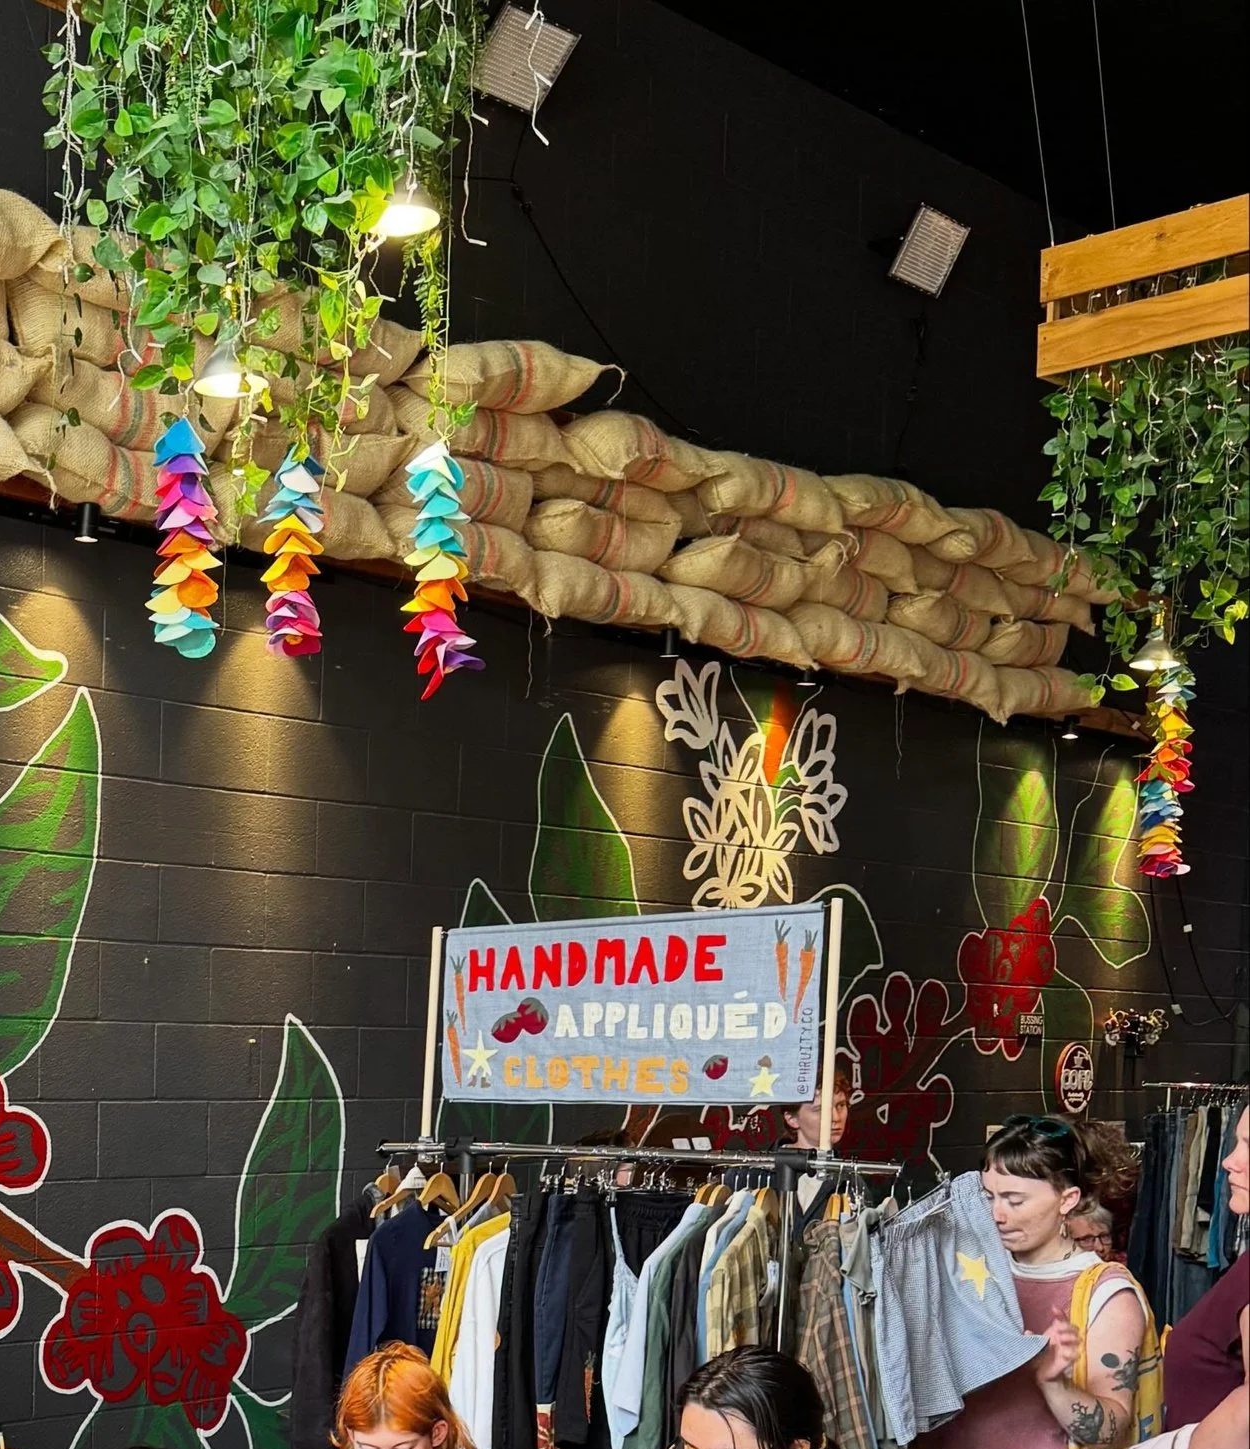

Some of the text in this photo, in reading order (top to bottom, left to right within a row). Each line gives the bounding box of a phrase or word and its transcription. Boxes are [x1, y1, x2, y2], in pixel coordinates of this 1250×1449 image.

[467, 934, 728, 993] HANDMADE
[553, 990, 788, 1041] APPLIQUÉD
[503, 1054, 691, 1095] CLOTHES
